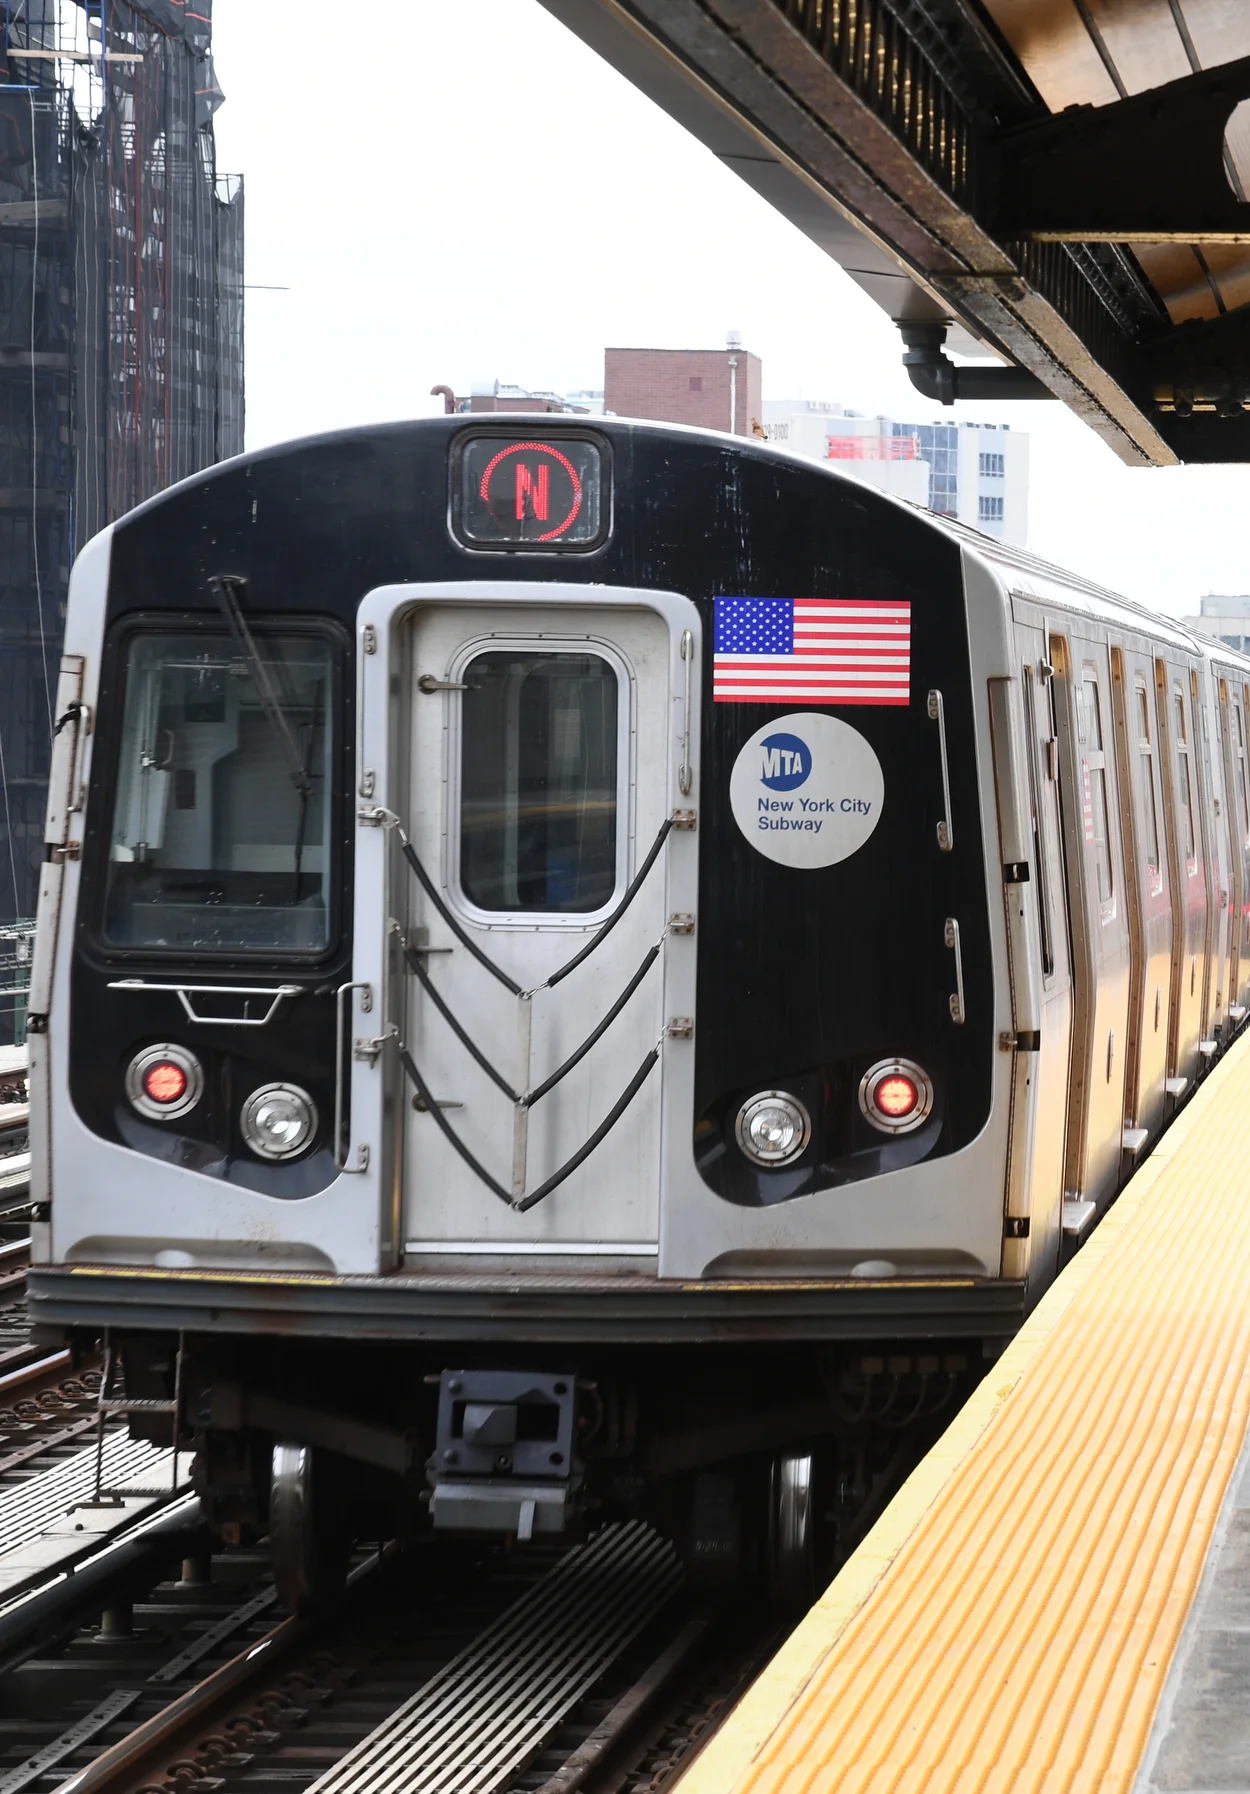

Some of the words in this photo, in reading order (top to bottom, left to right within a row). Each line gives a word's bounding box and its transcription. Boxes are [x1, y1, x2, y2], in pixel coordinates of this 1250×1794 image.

[515, 464, 549, 521] N
[759, 745, 803, 780] MTA
[758, 798, 794, 812] New
[799, 798, 835, 813] York
[840, 798, 872, 816] City
[758, 816, 823, 834] Subway
